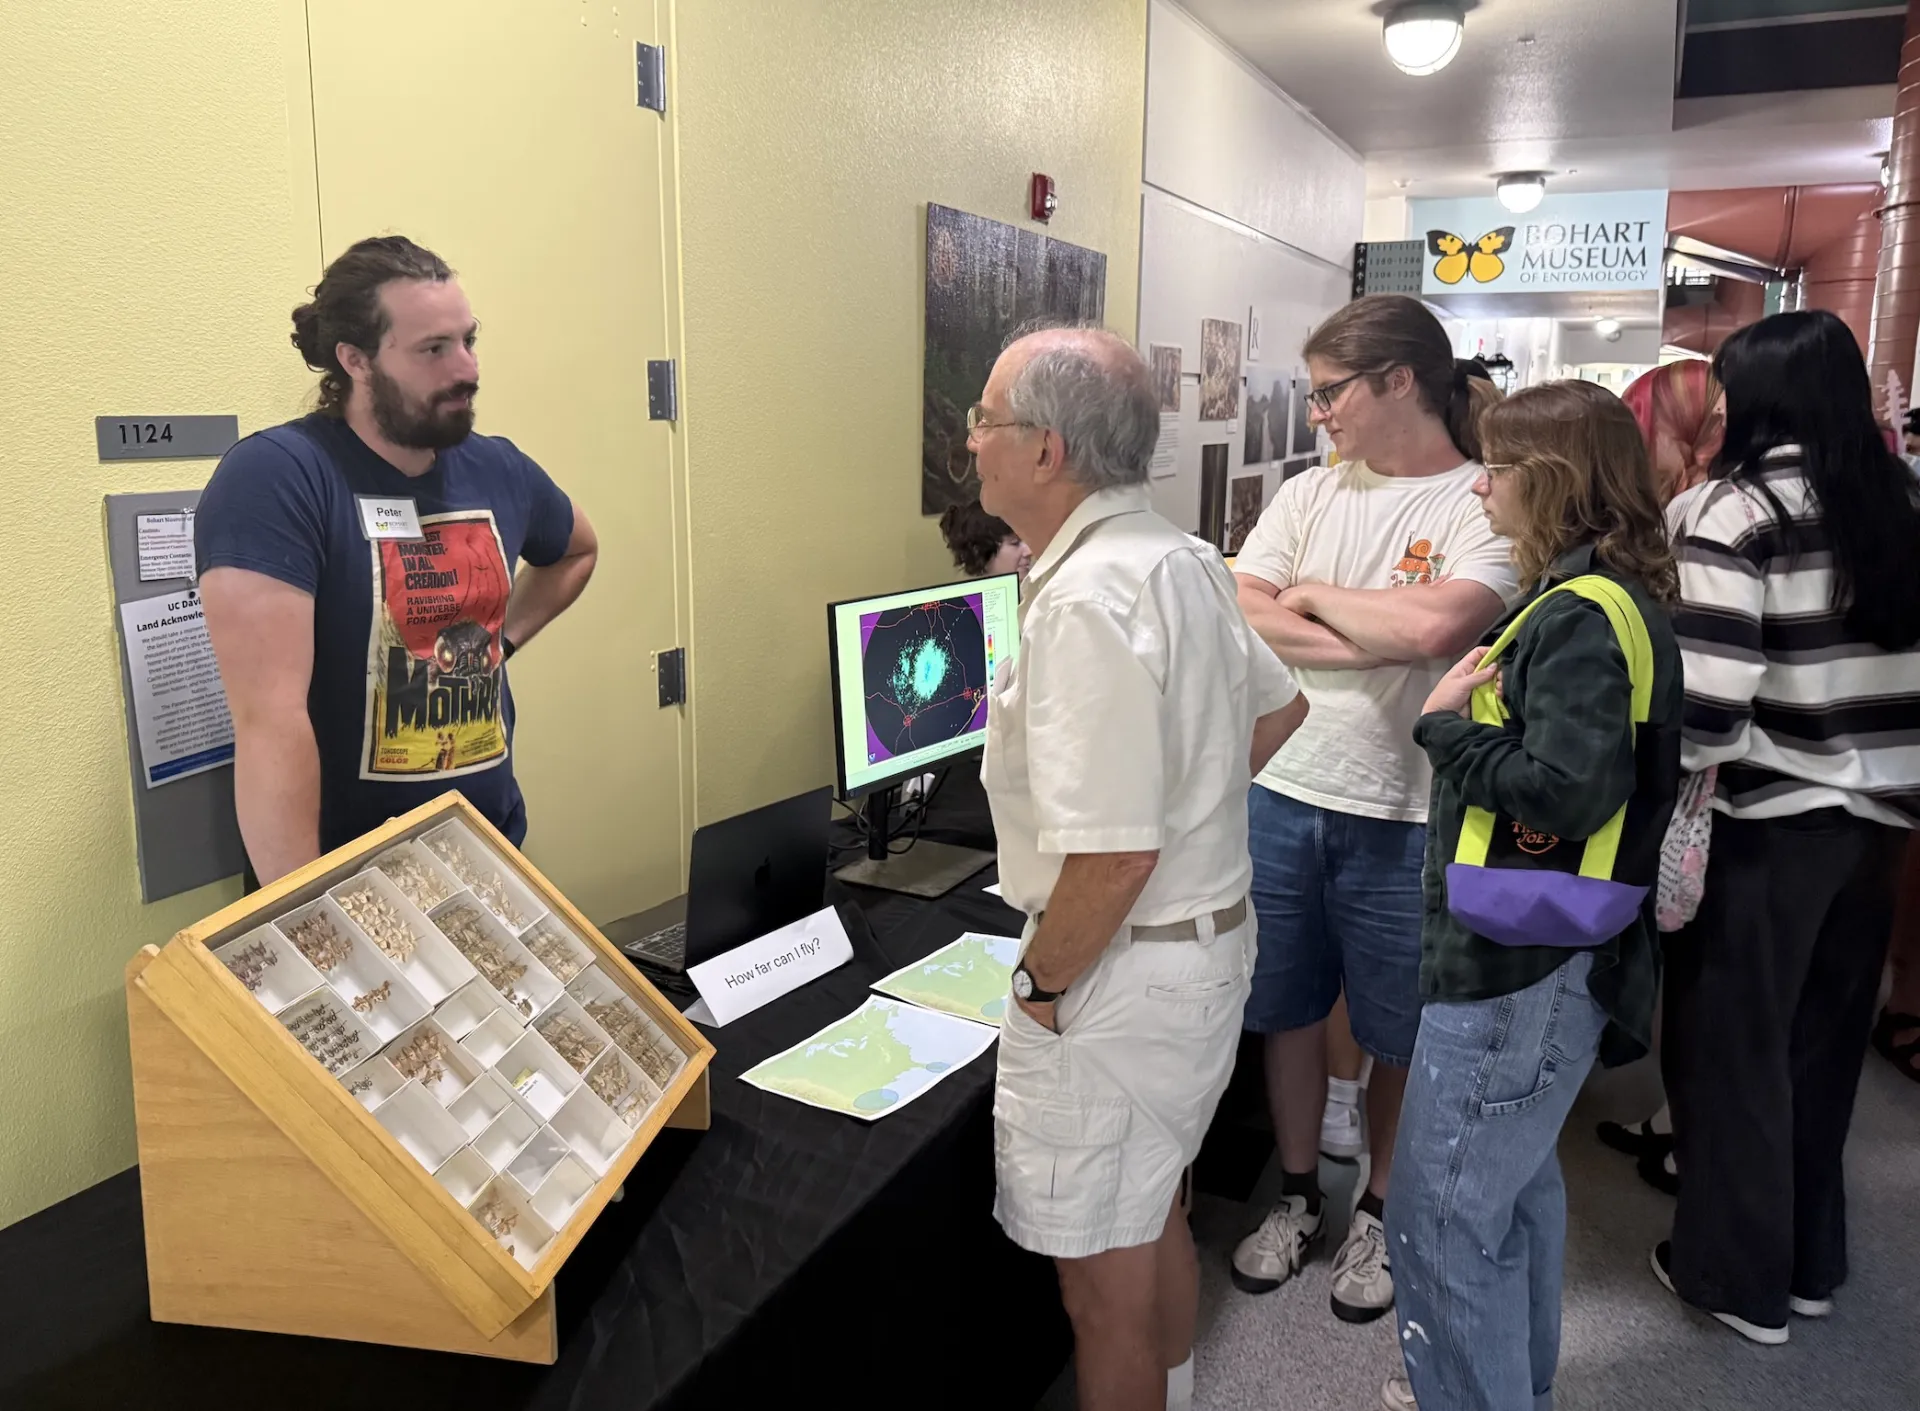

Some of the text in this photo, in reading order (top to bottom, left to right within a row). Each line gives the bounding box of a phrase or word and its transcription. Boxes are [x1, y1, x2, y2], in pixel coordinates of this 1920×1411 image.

[1526, 221, 1650, 245] BOHART
[1522, 246, 1647, 269] MUSEUM
[1520, 270, 1648, 283] OF ENTOMOLOGY
[119, 423, 173, 445] 1124
[376, 507, 402, 517] Peter
[425, 531, 441, 543] EST
[402, 557, 417, 572] IN
[405, 569, 459, 590] CREATION!
[168, 597, 201, 611] UC Davi
[407, 595, 455, 605] RAVISHING
[407, 603, 461, 616] A UNIVERSE
[137, 611, 204, 632] Land Acknowle
[407, 616, 426, 625] FOR
[724, 974, 755, 989] How
[754, 963, 773, 976] far
[773, 952, 795, 968] can
[800, 937, 821, 956] fly?
